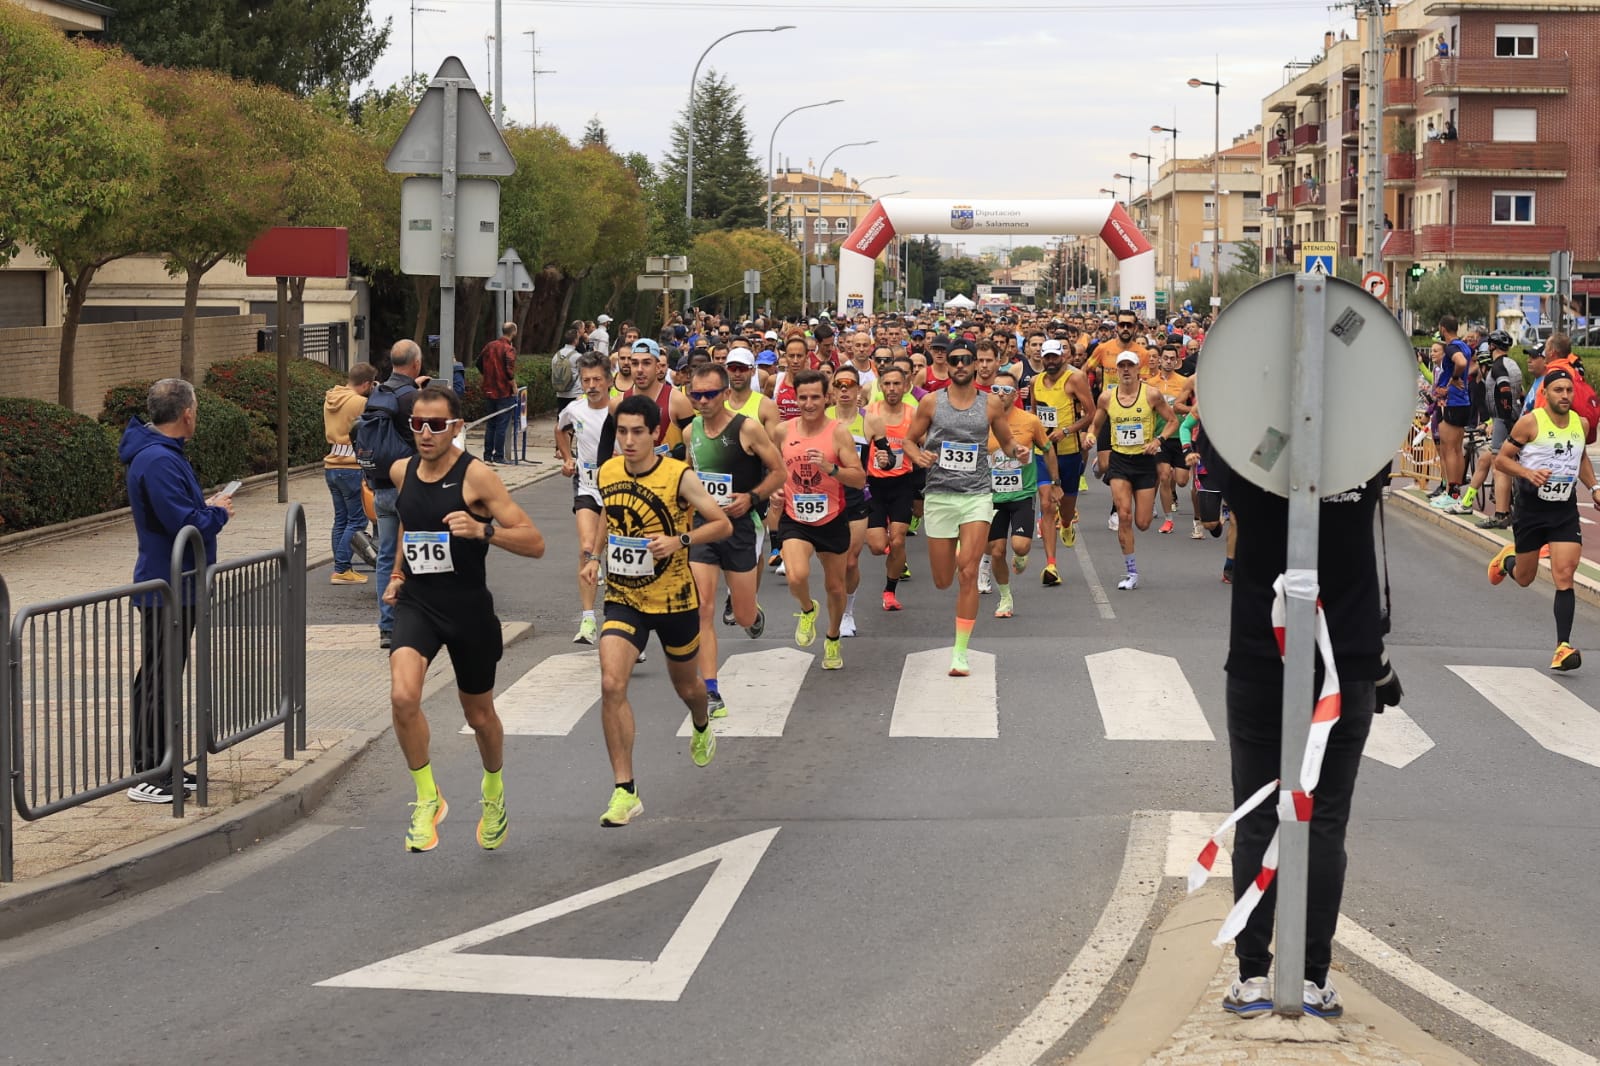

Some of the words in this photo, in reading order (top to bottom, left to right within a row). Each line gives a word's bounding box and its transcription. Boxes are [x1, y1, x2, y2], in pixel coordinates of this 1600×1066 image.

[975, 209, 1021, 217] Diputación
[985, 220, 1030, 228] Salamanca
[1465, 283, 1488, 291] Virgen
[1121, 430, 1137, 440] 75
[944, 449, 974, 463] 333
[995, 476, 1019, 486] 229
[702, 481, 727, 496] 09
[1543, 482, 1570, 494] 547
[797, 502, 824, 514] 595
[406, 543, 446, 562] 516
[611, 547, 647, 565] 467
